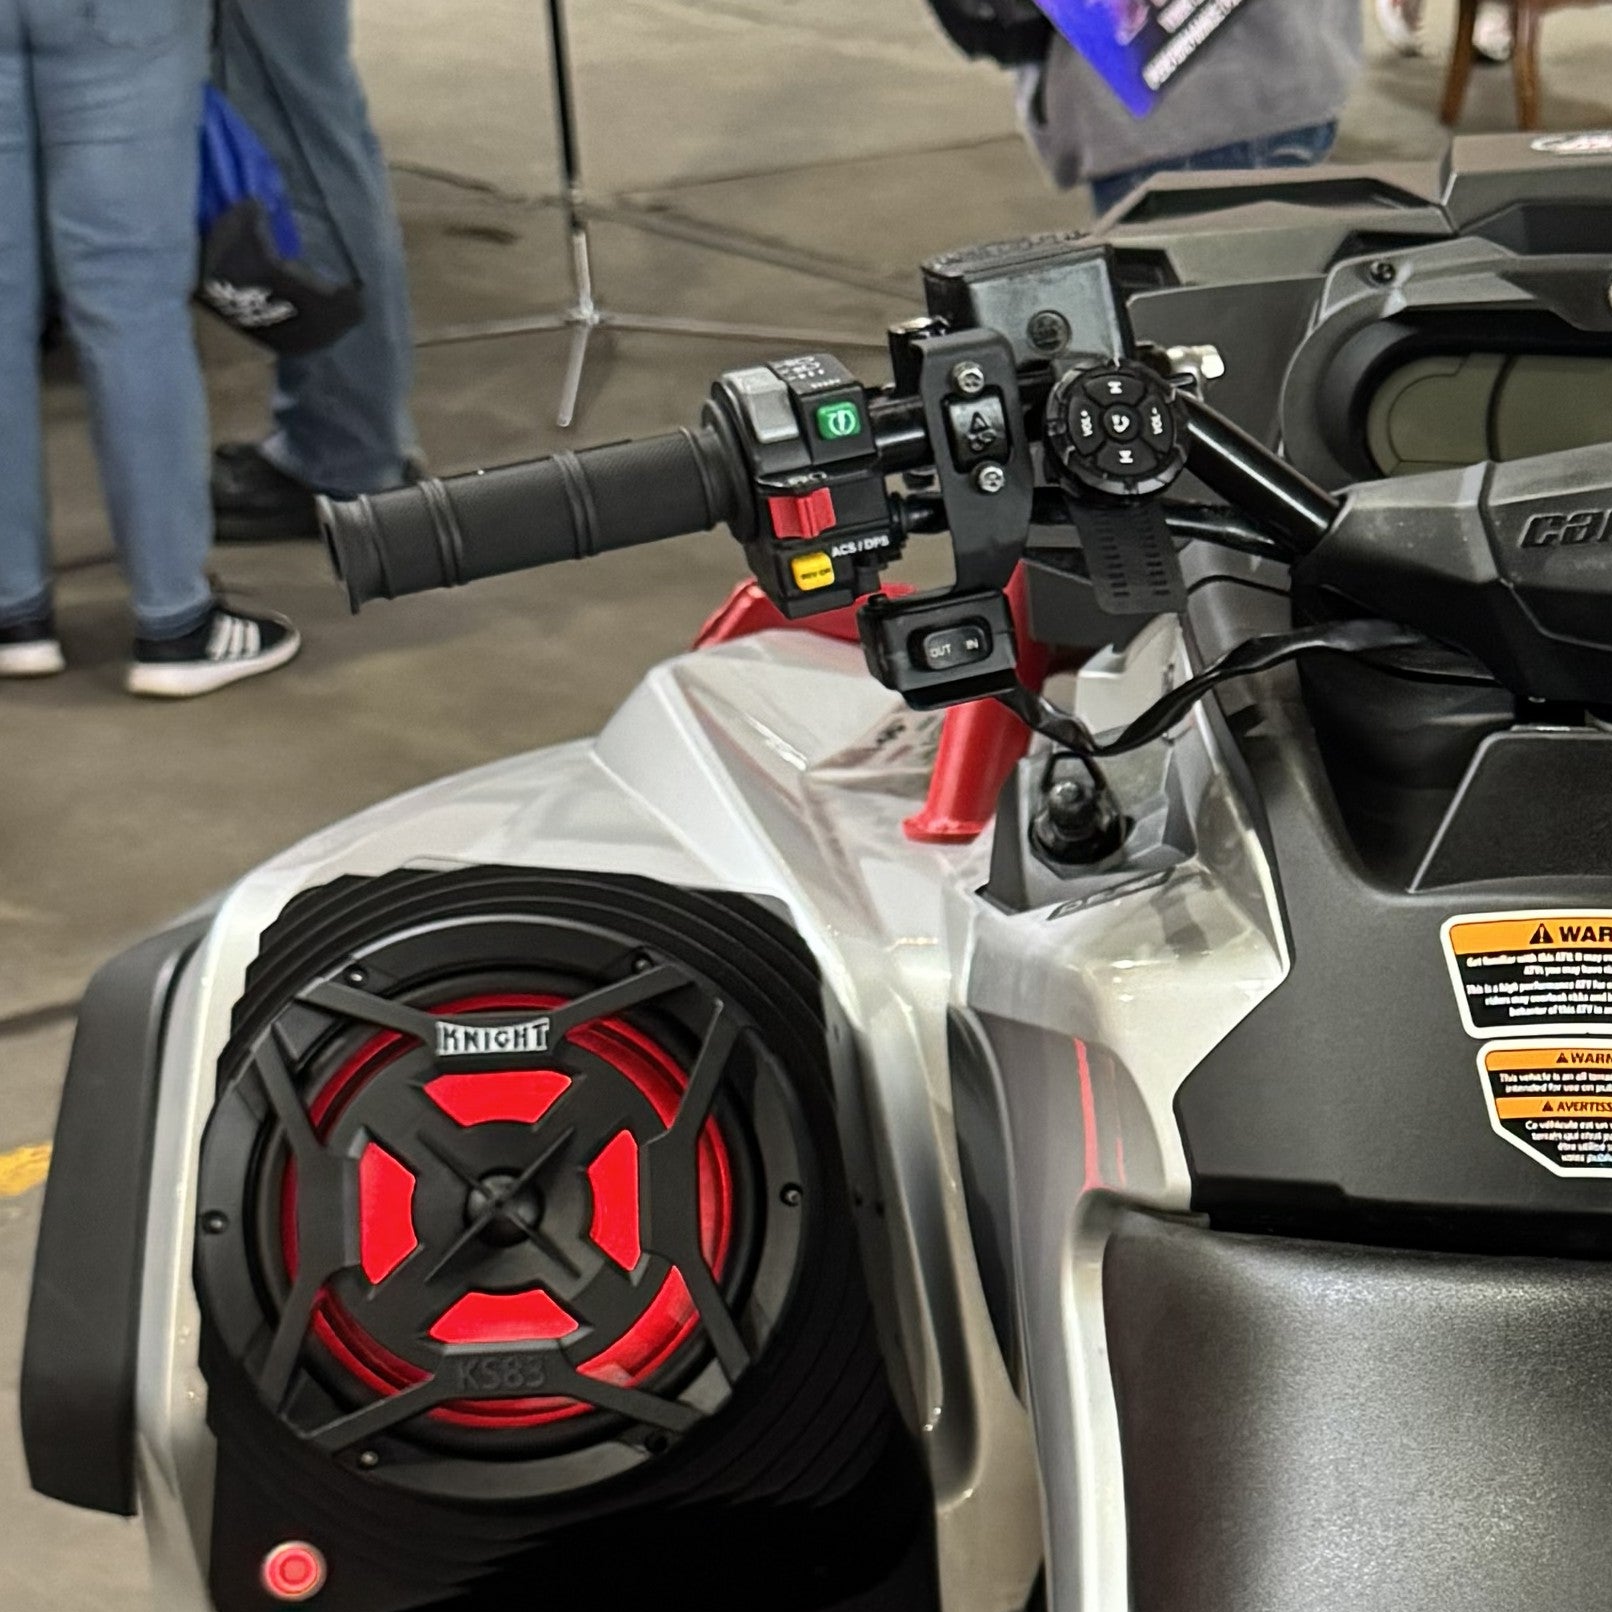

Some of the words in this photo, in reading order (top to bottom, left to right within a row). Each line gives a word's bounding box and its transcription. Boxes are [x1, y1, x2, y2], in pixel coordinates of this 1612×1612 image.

[832, 541, 857, 558] ACS
[864, 535, 890, 550] DPS
[930, 643, 951, 658] OUT
[965, 638, 979, 650] IN
[437, 1018, 549, 1055] KNIGHT
[456, 1354, 545, 1390] KS83
